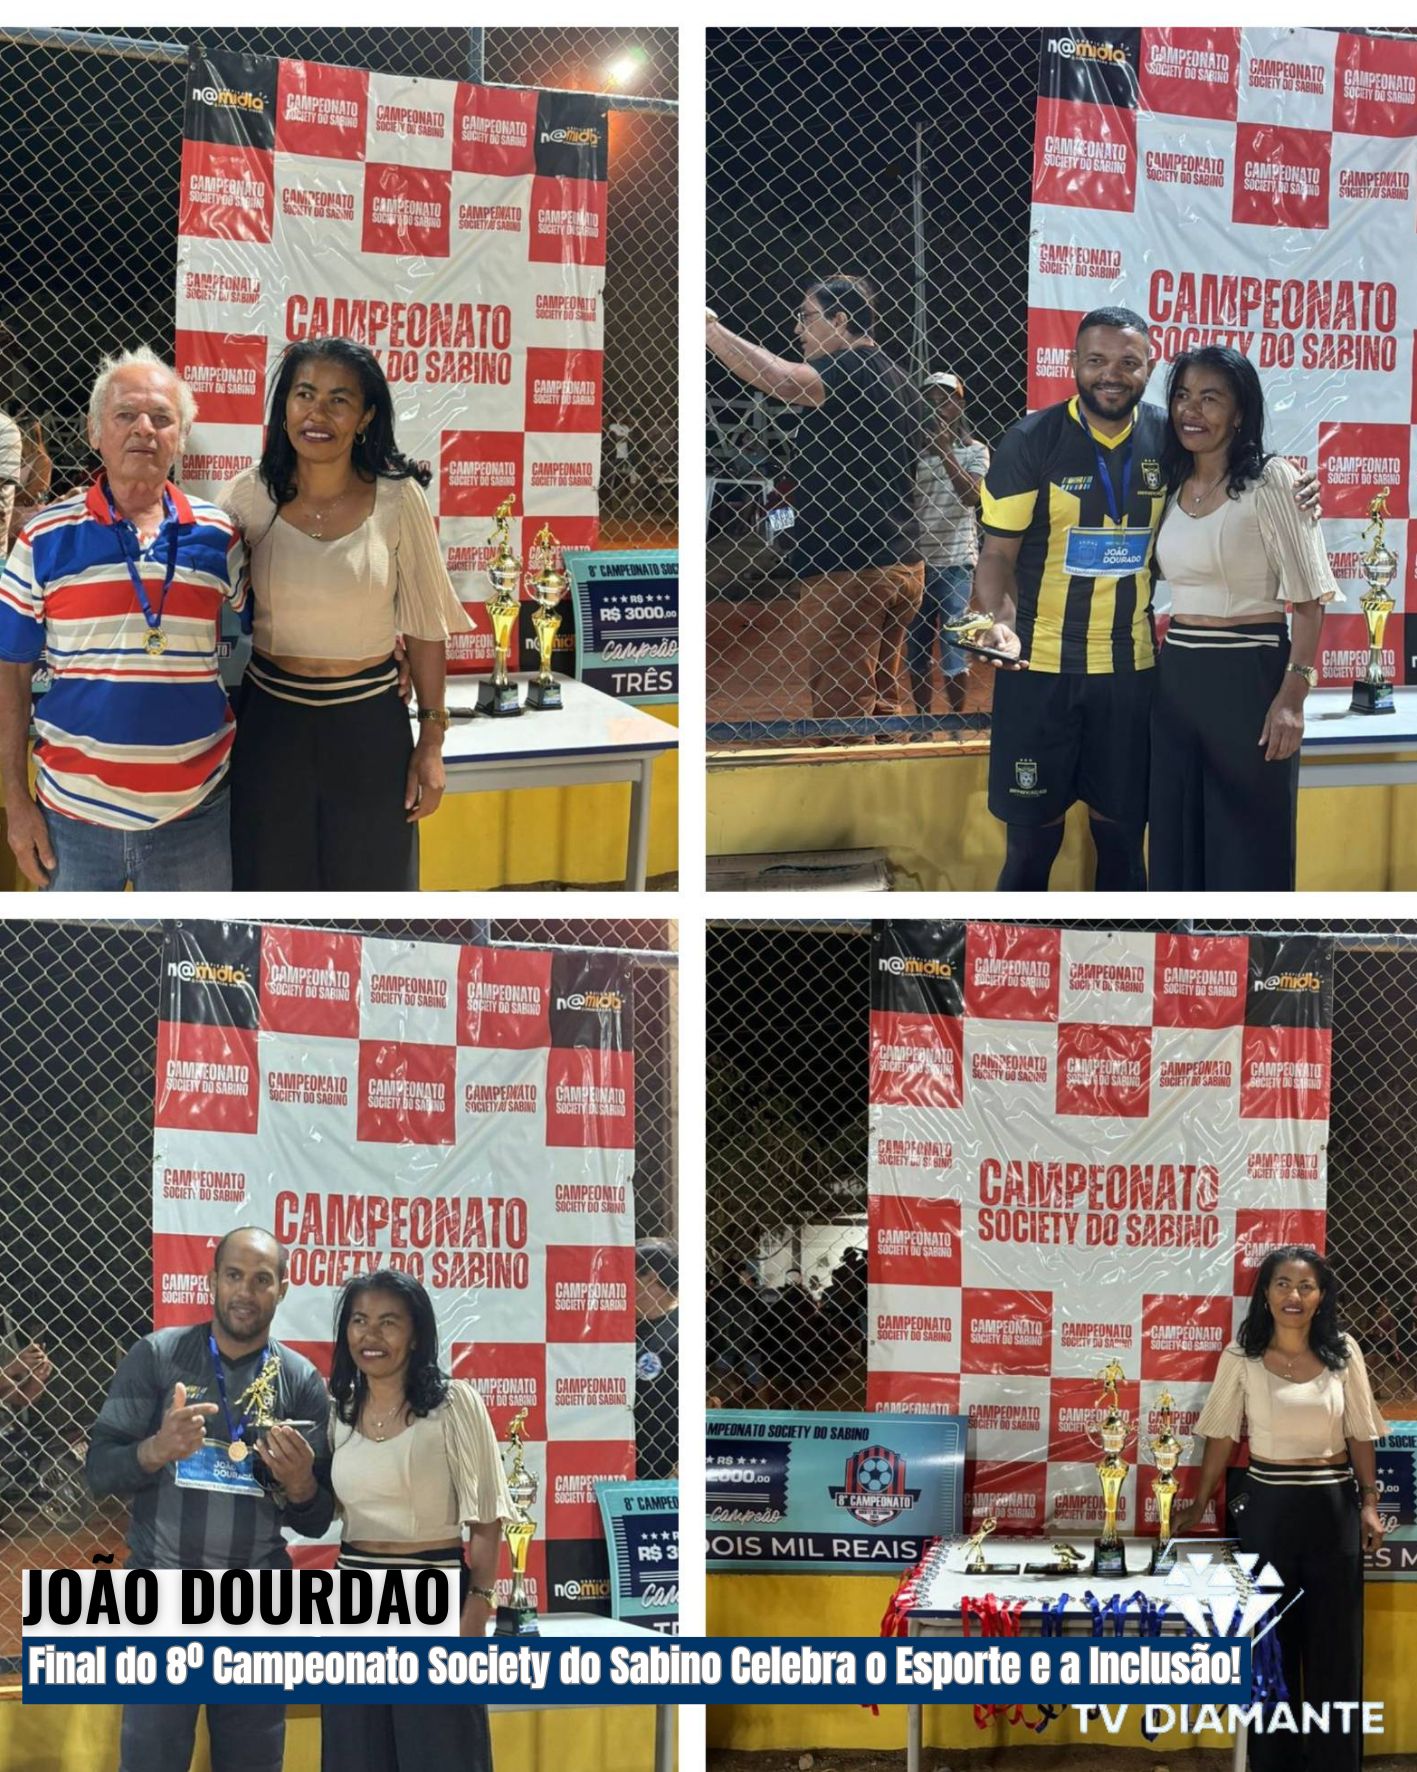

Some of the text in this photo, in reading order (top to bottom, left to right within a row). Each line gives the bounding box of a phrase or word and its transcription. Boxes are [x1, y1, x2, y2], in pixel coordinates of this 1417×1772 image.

[1151, 45, 1229, 72] CAMPEONATO
[1150, 62, 1228, 84] SOCIETY DO SABINO
[1250, 58, 1324, 83] CAMPEONATO
[1249, 75, 1324, 94] SOCIETY DO SABINO
[1345, 70, 1415, 93] CAMPEONATO
[1344, 86, 1415, 104] SOCIETY DO SABINO
[287, 94, 358, 117] CAMPEONATO
[287, 109, 357, 128] SOCIETY DO SABINO
[462, 116, 526, 137] CAMPEONATO
[462, 131, 526, 147] SOCIETY DO SABINO
[1147, 151, 1224, 175] CAMPEONATO
[1147, 169, 1223, 187] SOCIETY DO SABINO
[1149, 269, 1397, 333] CAMPEONATO
[286, 294, 511, 349] CAMPEONATO
[1260, 332, 1295, 368] DO
[1302, 333, 1397, 372] SABINO
[184, 366, 256, 383] CAMPEONATO
[387, 351, 512, 385] DO SABINO
[228, 384, 256, 395] SABINO
[449, 461, 515, 476] CAMPEONATO
[532, 462, 592, 476] CAMPEONATO
[1328, 456, 1400, 474] CAMPEONATO
[182, 469, 222, 480] SOCIETY DO
[449, 475, 515, 486] SOCIETY DO SABINO
[532, 476, 592, 486] SOCIETY DO SABINO
[1328, 472, 1400, 485] SOCIETY DO SABINO
[1103, 555, 1142, 564] DOURADO
[601, 563, 659, 577] CAMPEONATO
[630, 595, 643, 603] R$
[600, 606, 677, 622] R$ 3000,00
[611, 667, 673, 694] TRÊS
[371, 974, 446, 996] CAMPEONATO
[1164, 968, 1237, 986] CAMPEONATO
[468, 982, 540, 1004] CAMPEONATO
[1164, 983, 1237, 997] SOCIETY DO SABINO
[371, 991, 446, 1008] SOCIETY DO SABINO
[468, 999, 540, 1016] SOCIETY DO SABINO
[269, 1072, 347, 1094] CAMPEONATO
[269, 1089, 347, 1106] SOCIETY DO SABINO
[979, 1158, 1219, 1212] CAMPEONATO
[275, 1191, 528, 1249] CAMPEONATO
[978, 1208, 1219, 1249] SOCIETY DO SABINO
[878, 1229, 951, 1247] CAMPEONATO
[878, 1244, 951, 1257] SOCIETY DO SABINO
[283, 1248, 383, 1287] OCIETY
[432, 1251, 529, 1290] SABINO
[162, 1291, 208, 1305] SOCIETY DO
[556, 1282, 626, 1299] CAMPEONATO
[555, 1299, 626, 1311] SOCIETY DO SABINO
[878, 1315, 951, 1332] CAMPEONATO
[971, 1319, 1042, 1335] CAMPEONATO
[878, 1330, 951, 1342] SOCIETY DO SABINO
[971, 1334, 1042, 1345] SOCIETY DO SABINO
[556, 1378, 626, 1394] CAMPEONATO
[556, 1394, 626, 1405] SOCIETY DO SABINO
[969, 1405, 1040, 1421] CAMPEONATO
[706, 1422, 869, 1441] MPEONATO SOCIETY DO SABINO
[968, 1419, 1040, 1431] SOCIETY DO SABINO
[1388, 1435, 1417, 1448] SOCIE
[717, 1456, 733, 1465] R$
[637, 1496, 679, 1510] CAMPEO
[850, 1495, 911, 1508] CAMPEONATO
[638, 1544, 662, 1562] R$
[706, 1536, 918, 1559] OIS MIL REAIS
